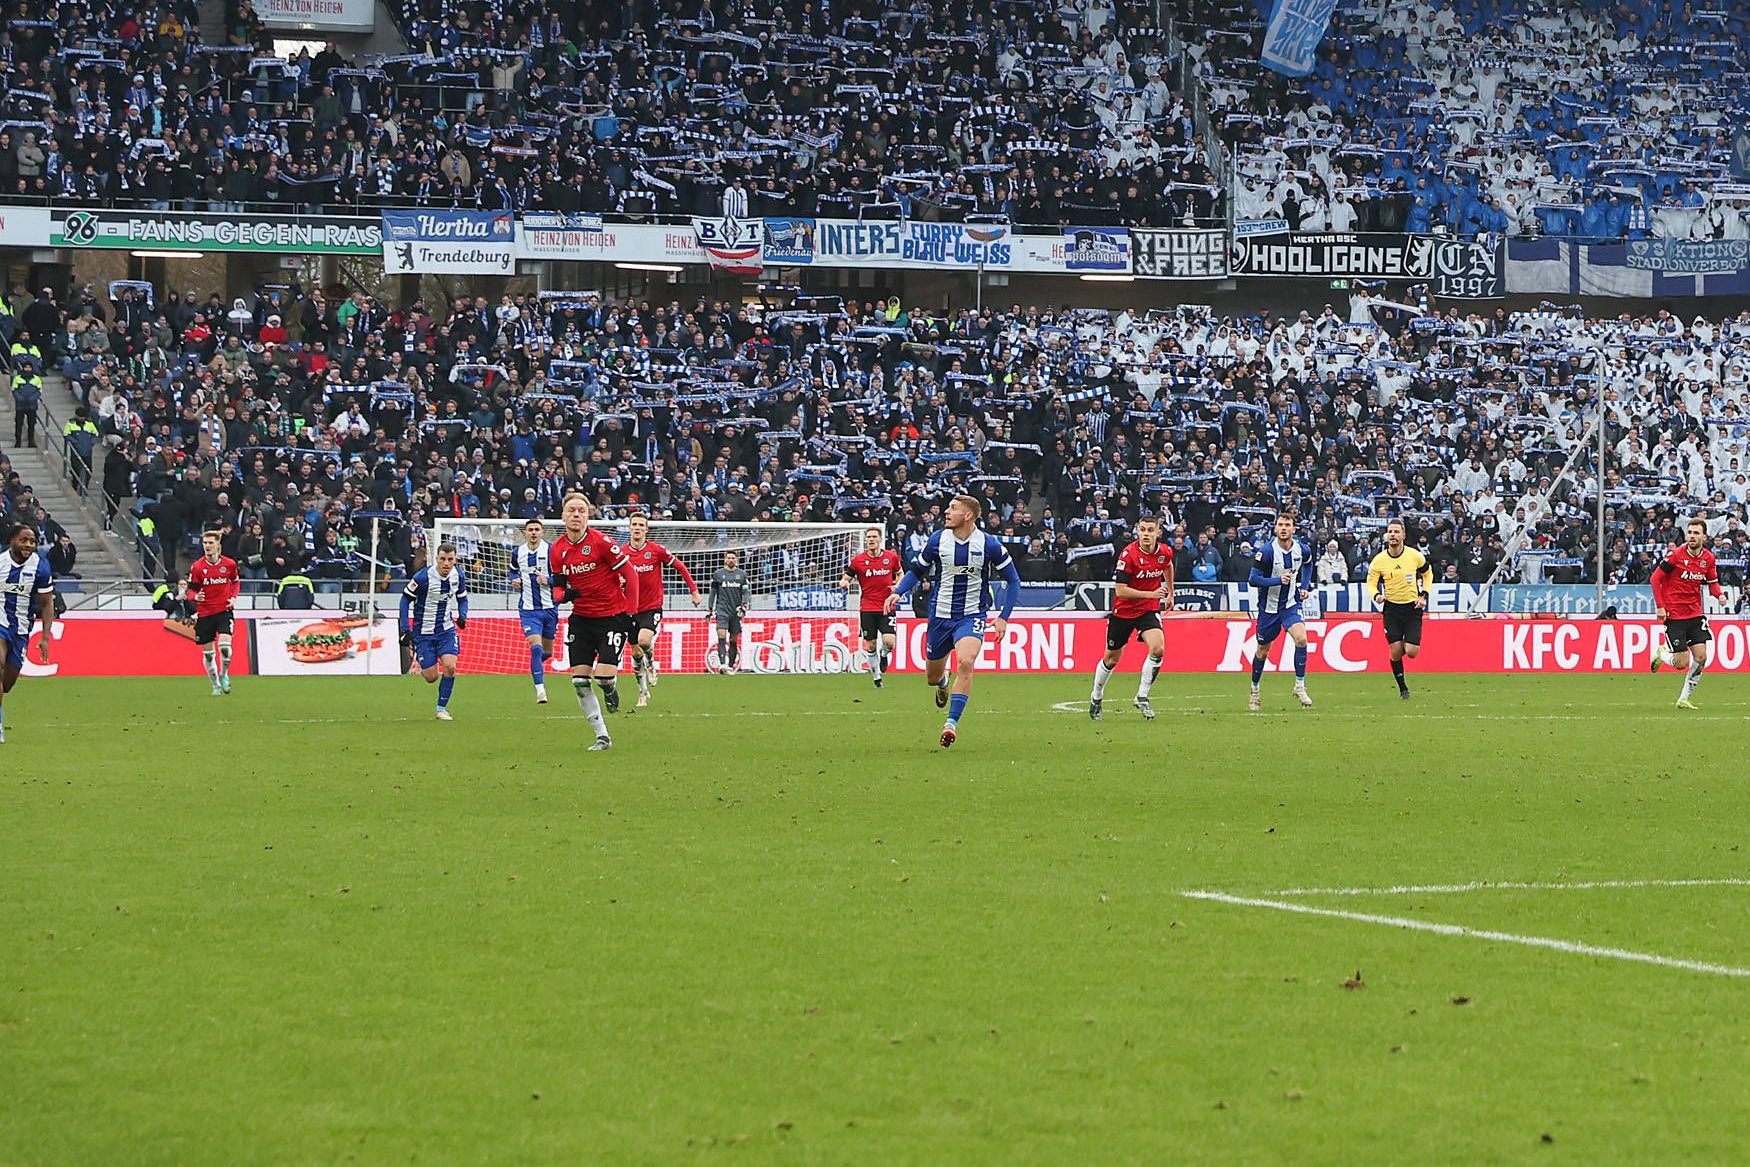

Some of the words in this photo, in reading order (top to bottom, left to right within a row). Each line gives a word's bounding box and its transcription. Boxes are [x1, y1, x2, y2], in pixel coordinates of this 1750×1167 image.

[294, 0, 312, 13] VON
[313, 0, 344, 14] HEIDEN
[63, 215, 100, 242] 96
[128, 218, 204, 244] FANS
[213, 221, 314, 246] GEGEN
[324, 224, 384, 248] RAS
[418, 215, 490, 239] Hertha
[746, 223, 759, 239] T
[910, 223, 964, 243] CURRY
[533, 231, 560, 246] HEINZ
[563, 232, 581, 247] VON
[583, 232, 616, 247] HEIDEN
[665, 233, 692, 249] HEINZ
[1135, 233, 1225, 253] YOUNG
[1293, 235, 1336, 244] HERTHA
[1336, 235, 1358, 244] BSC
[419, 247, 511, 269] Trendelburg
[764, 244, 813, 259] Friedenau
[902, 238, 1011, 265] BLAU-WEISS
[1653, 242, 1730, 259] SKTION
[1251, 244, 1402, 274] HOOLIGANS
[1626, 256, 1748, 272] STADIONVERBOT
[1437, 274, 1497, 297] 1997
[570, 562, 597, 575] heise
[633, 564, 654, 573] heise
[872, 568, 891, 577] heise
[961, 565, 975, 574] 24
[11, 584, 25, 594] 24
[209, 577, 227, 585] heise
[810, 591, 845, 609] FANS
[606, 631, 622, 647] 16
[1503, 623, 1581, 670] KFC
